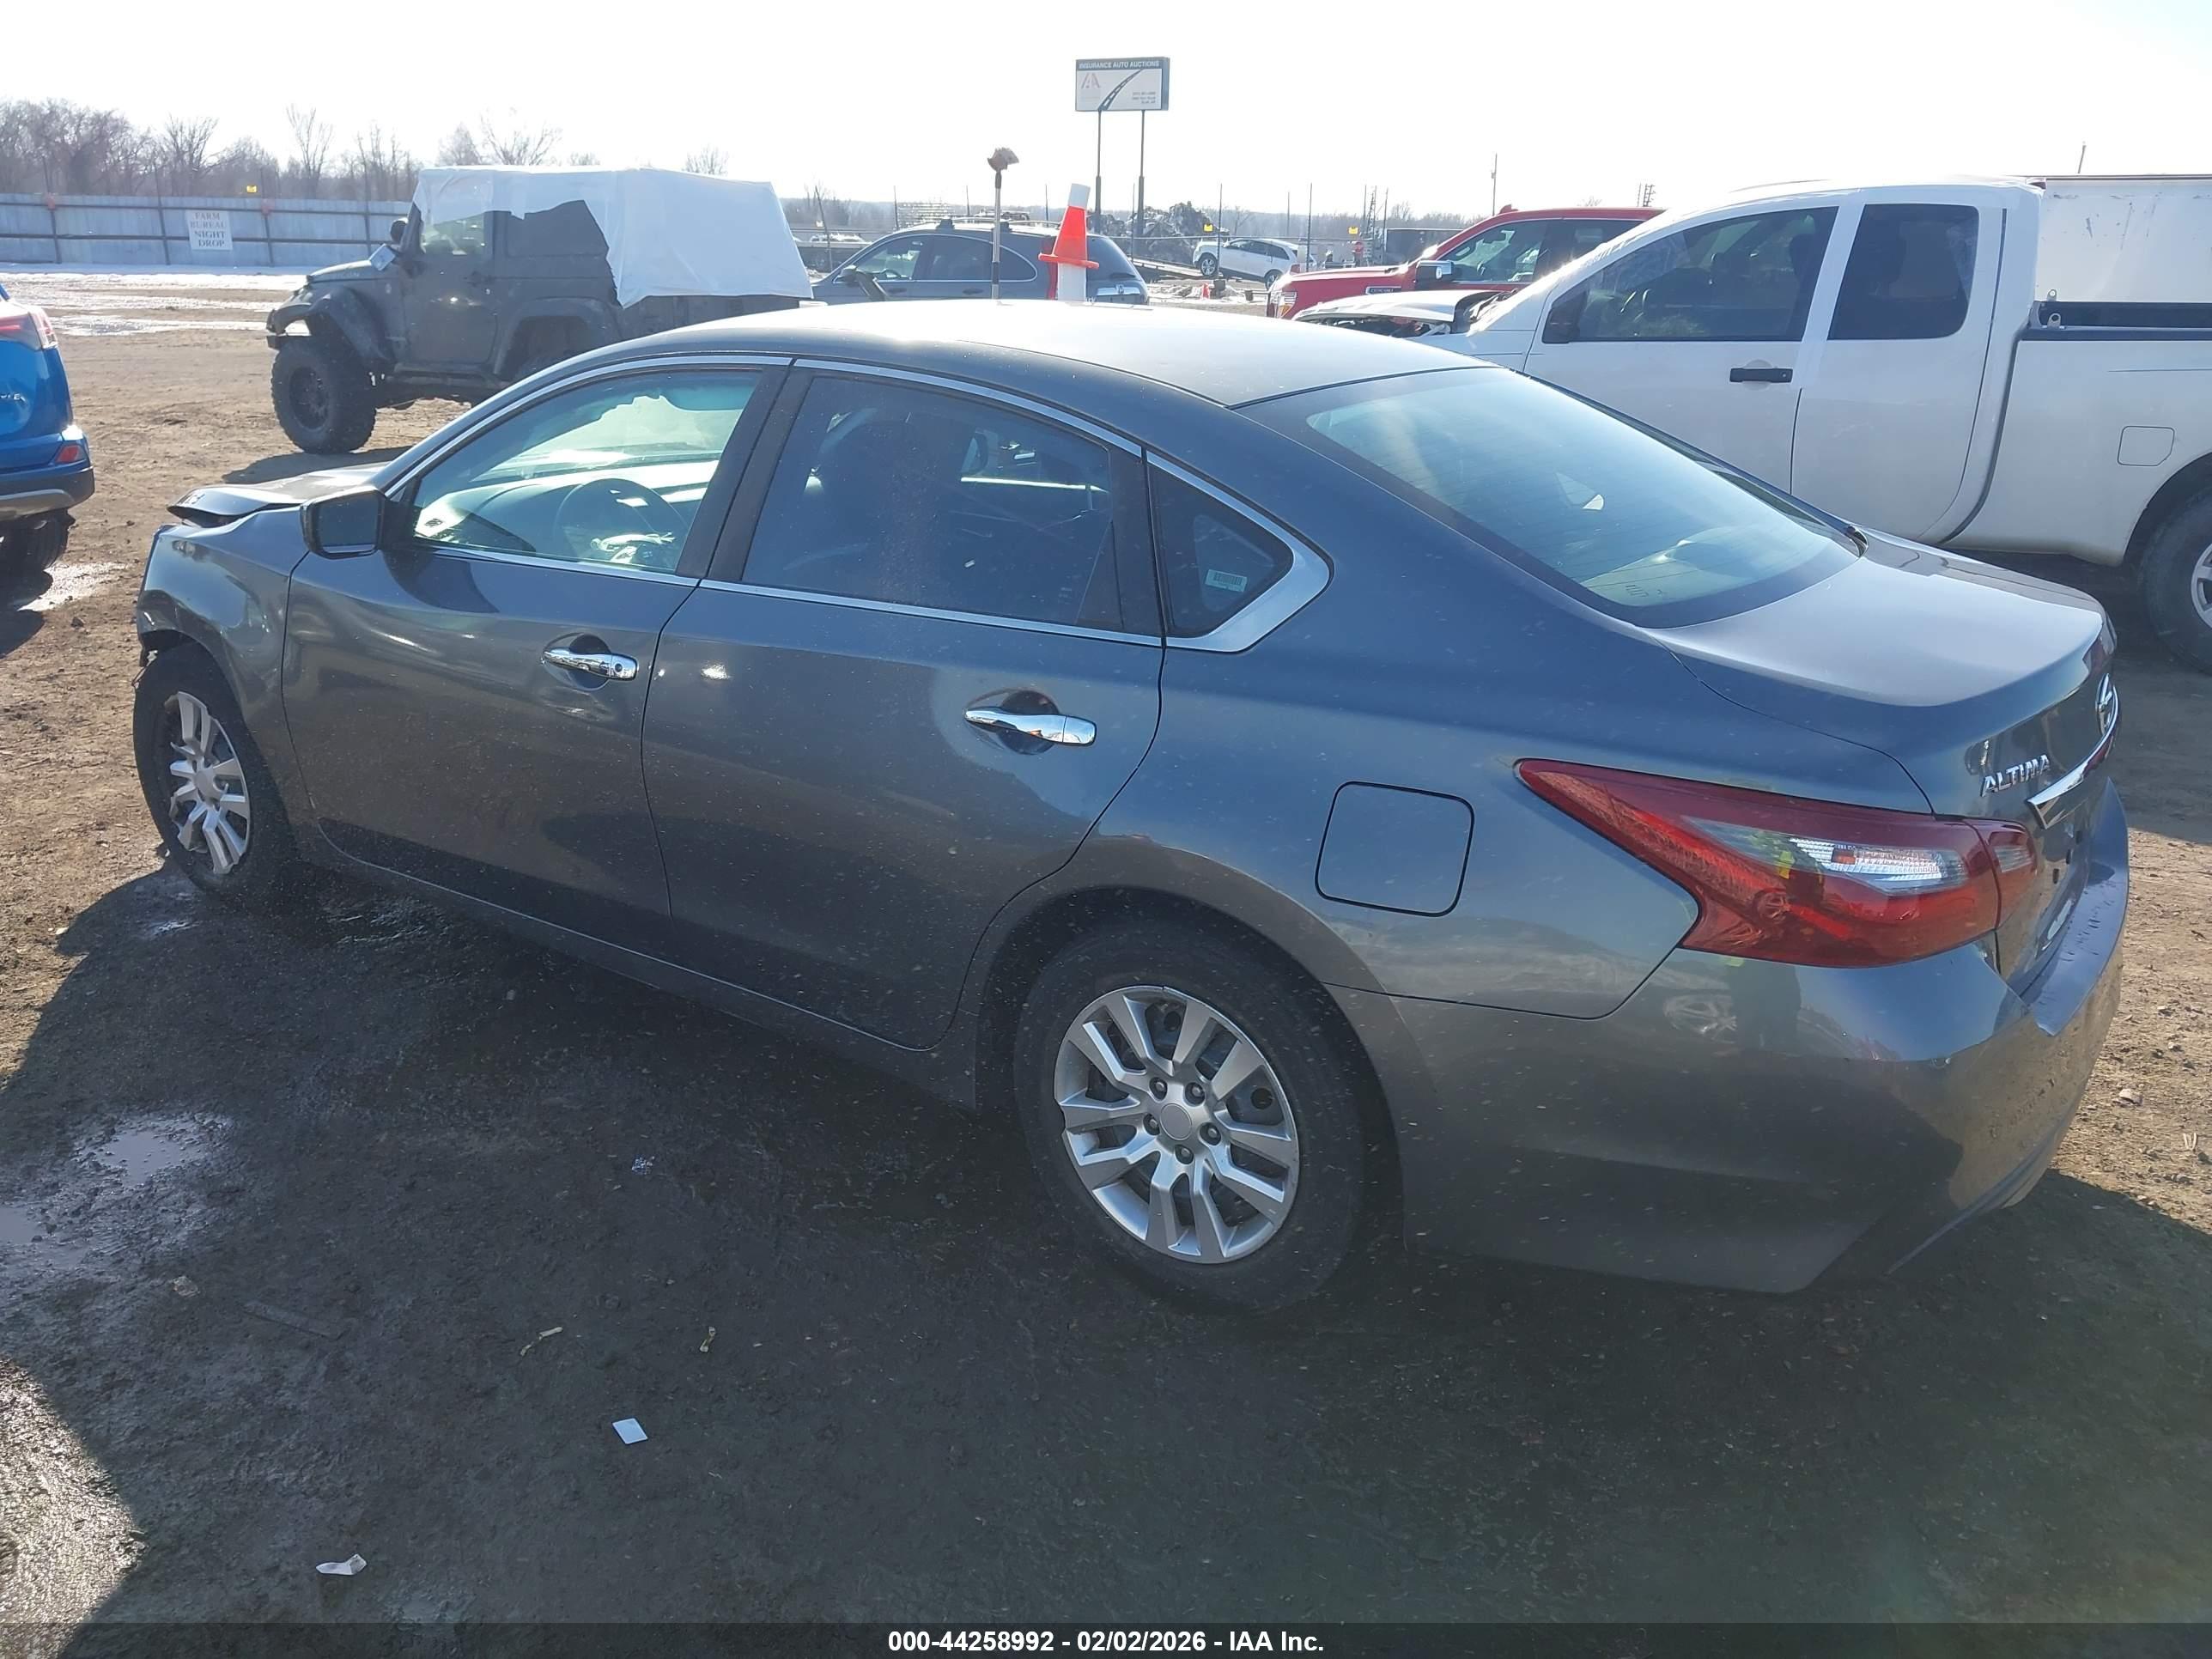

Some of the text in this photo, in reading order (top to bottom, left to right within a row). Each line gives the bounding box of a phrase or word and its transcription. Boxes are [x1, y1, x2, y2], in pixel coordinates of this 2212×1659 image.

[195, 212, 220, 221] FARM
[194, 230, 226, 239] NIGHT
[198, 239, 225, 247] DROP
[1980, 754, 2051, 798] ALTIMA
